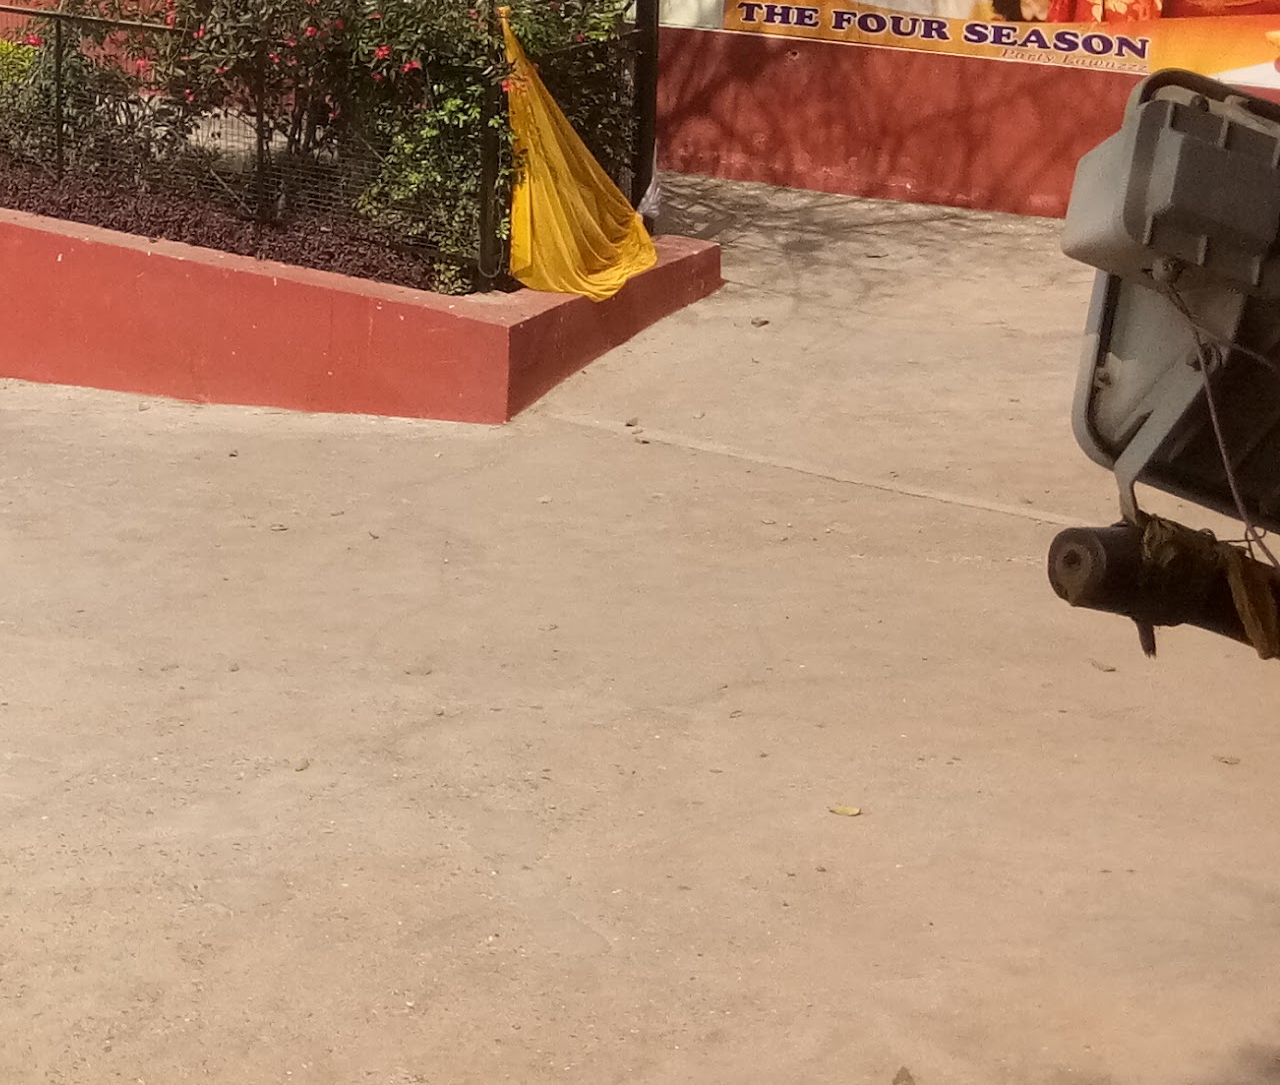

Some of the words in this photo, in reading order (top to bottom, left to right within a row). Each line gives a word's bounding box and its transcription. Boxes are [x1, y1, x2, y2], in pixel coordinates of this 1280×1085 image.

[738, 2, 819, 27] THE
[833, 10, 950, 41] FOUR
[963, 23, 1149, 59] SEASON
[1001, 48, 1055, 65] Party
